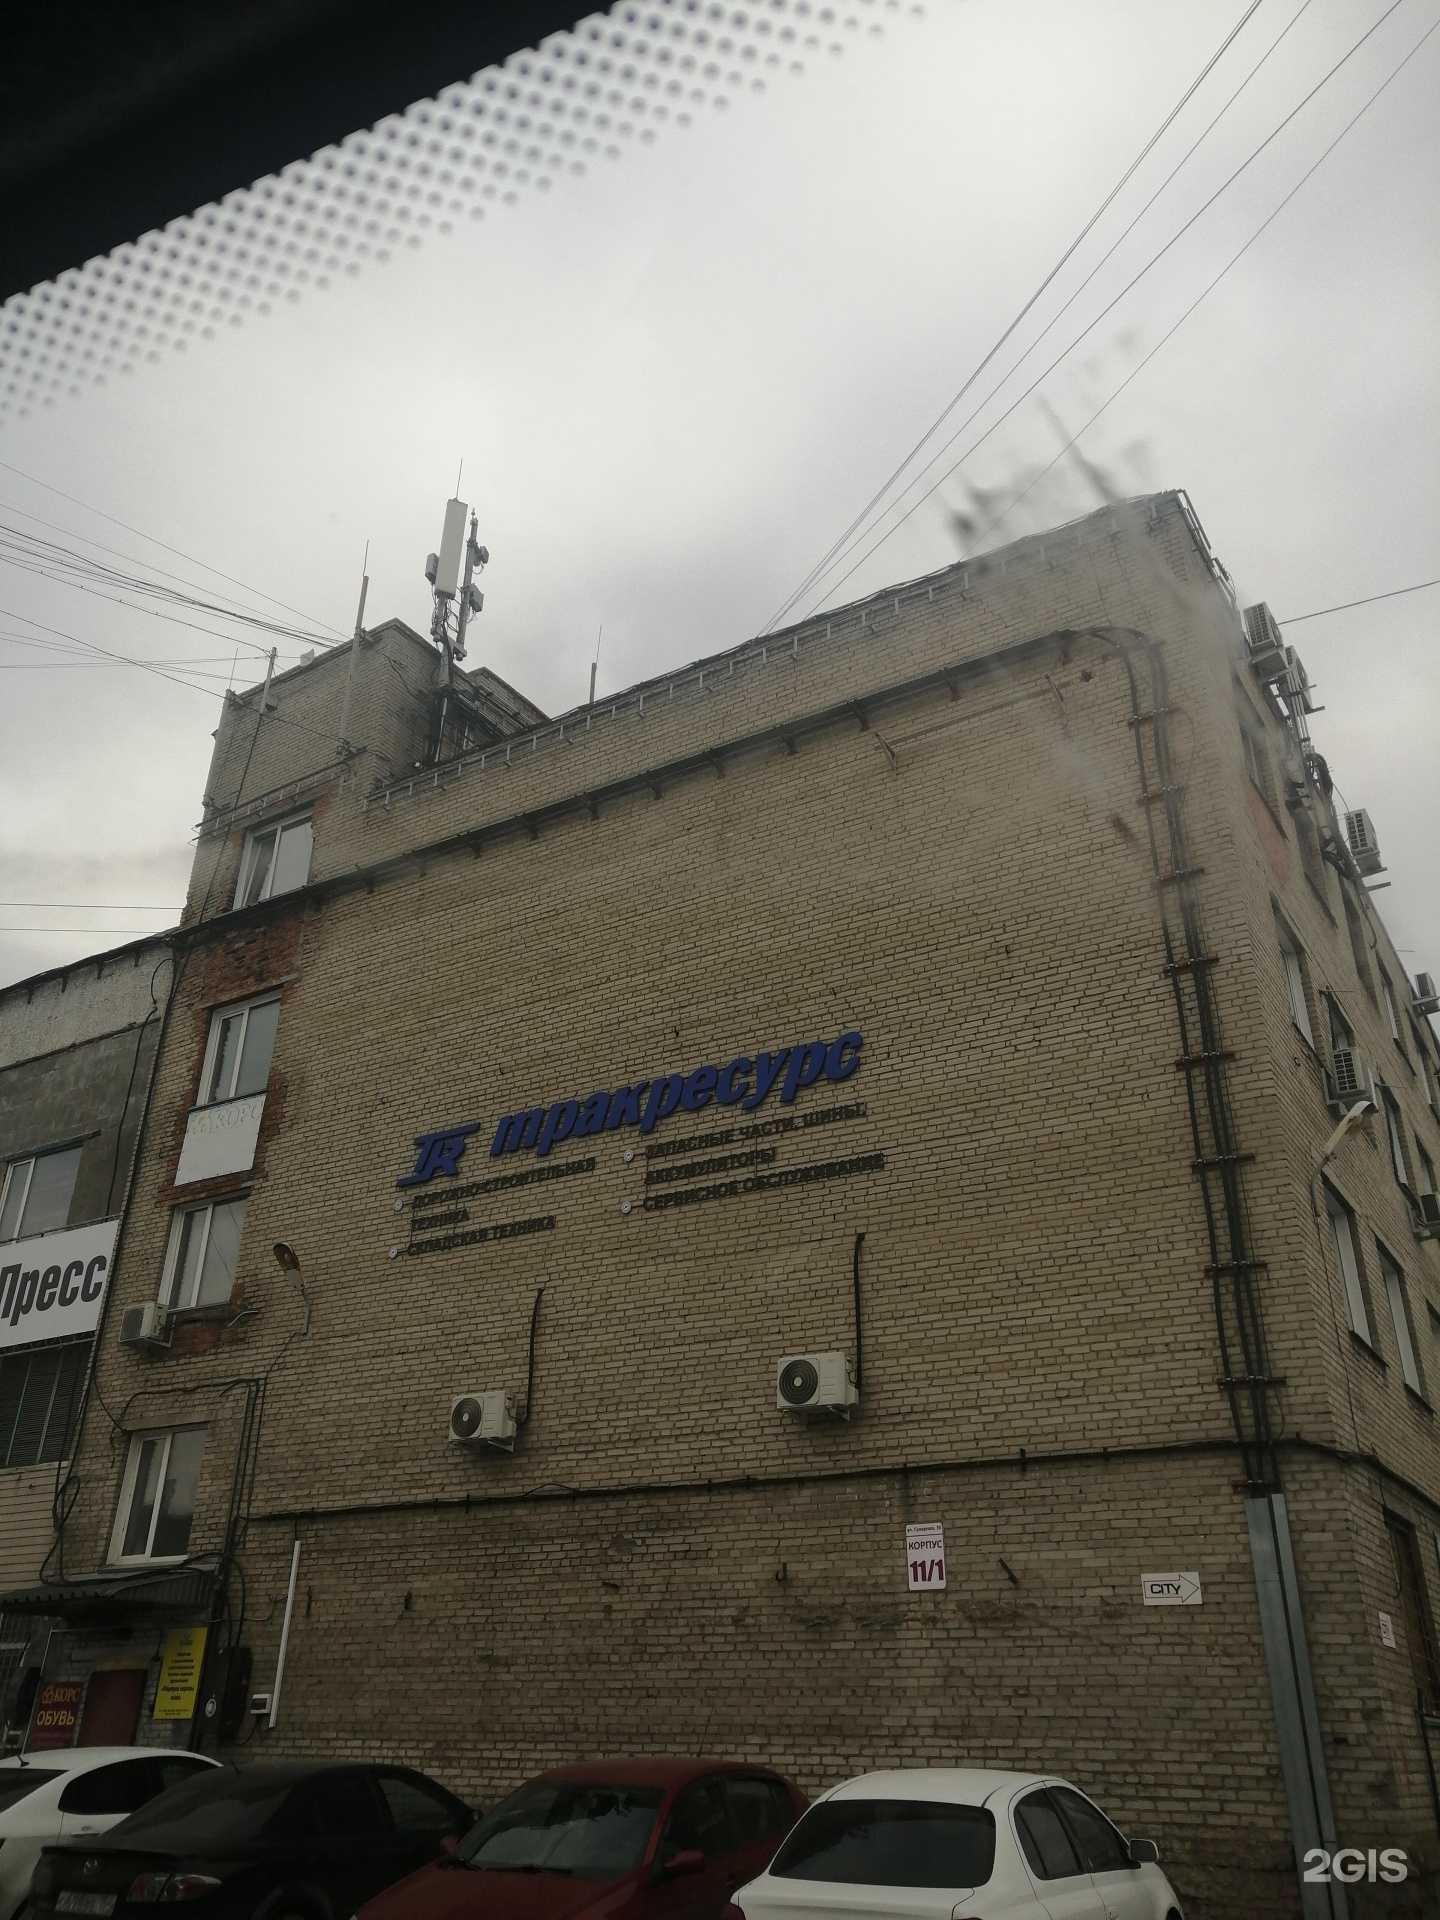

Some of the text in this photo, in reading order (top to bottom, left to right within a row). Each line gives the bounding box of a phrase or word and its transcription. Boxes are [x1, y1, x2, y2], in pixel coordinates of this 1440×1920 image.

[490, 1031, 863, 1157] тракресурс
[908, 1539, 943, 1550] КОРПУС
[910, 1559, 944, 1582] 11/1
[1150, 1583, 1181, 1595] CITY
[36, 1710, 75, 1726] ОБУВЬ
